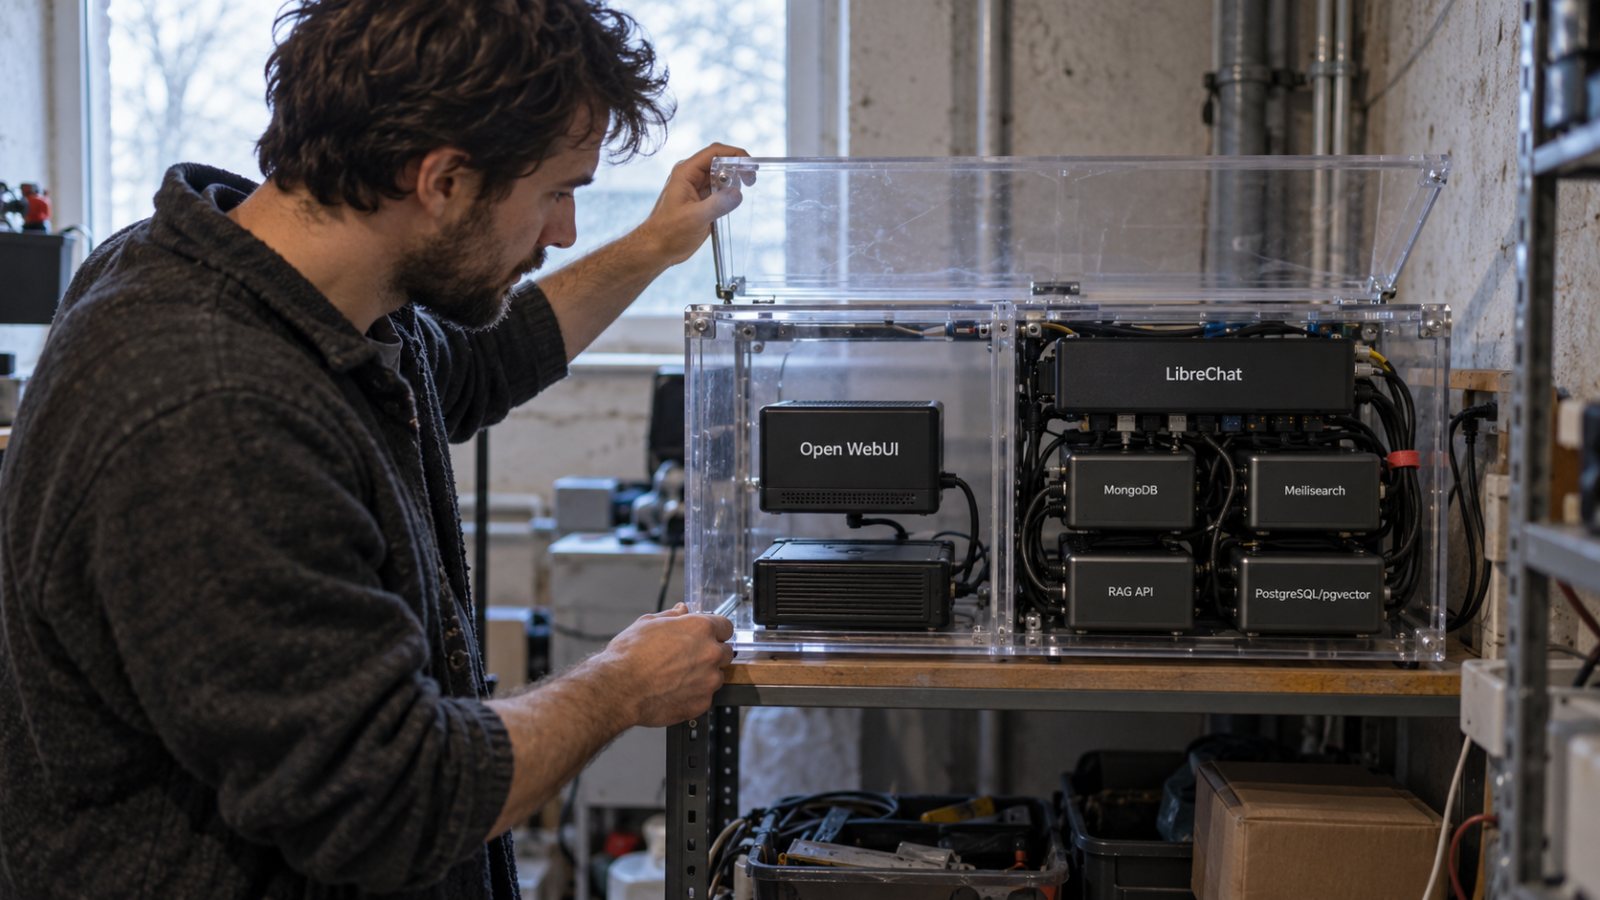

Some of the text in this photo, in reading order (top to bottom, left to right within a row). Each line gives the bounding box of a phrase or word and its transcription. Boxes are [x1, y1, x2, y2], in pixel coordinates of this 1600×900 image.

[1165, 366, 1243, 381] LibreChat
[800, 441, 899, 460] Open WebUI
[1104, 484, 1158, 497] MongoDB
[1284, 485, 1346, 496] Meilisearch
[1108, 586, 1154, 597] RAG API
[1255, 588, 1371, 602] PostgreSQL/pgvector
